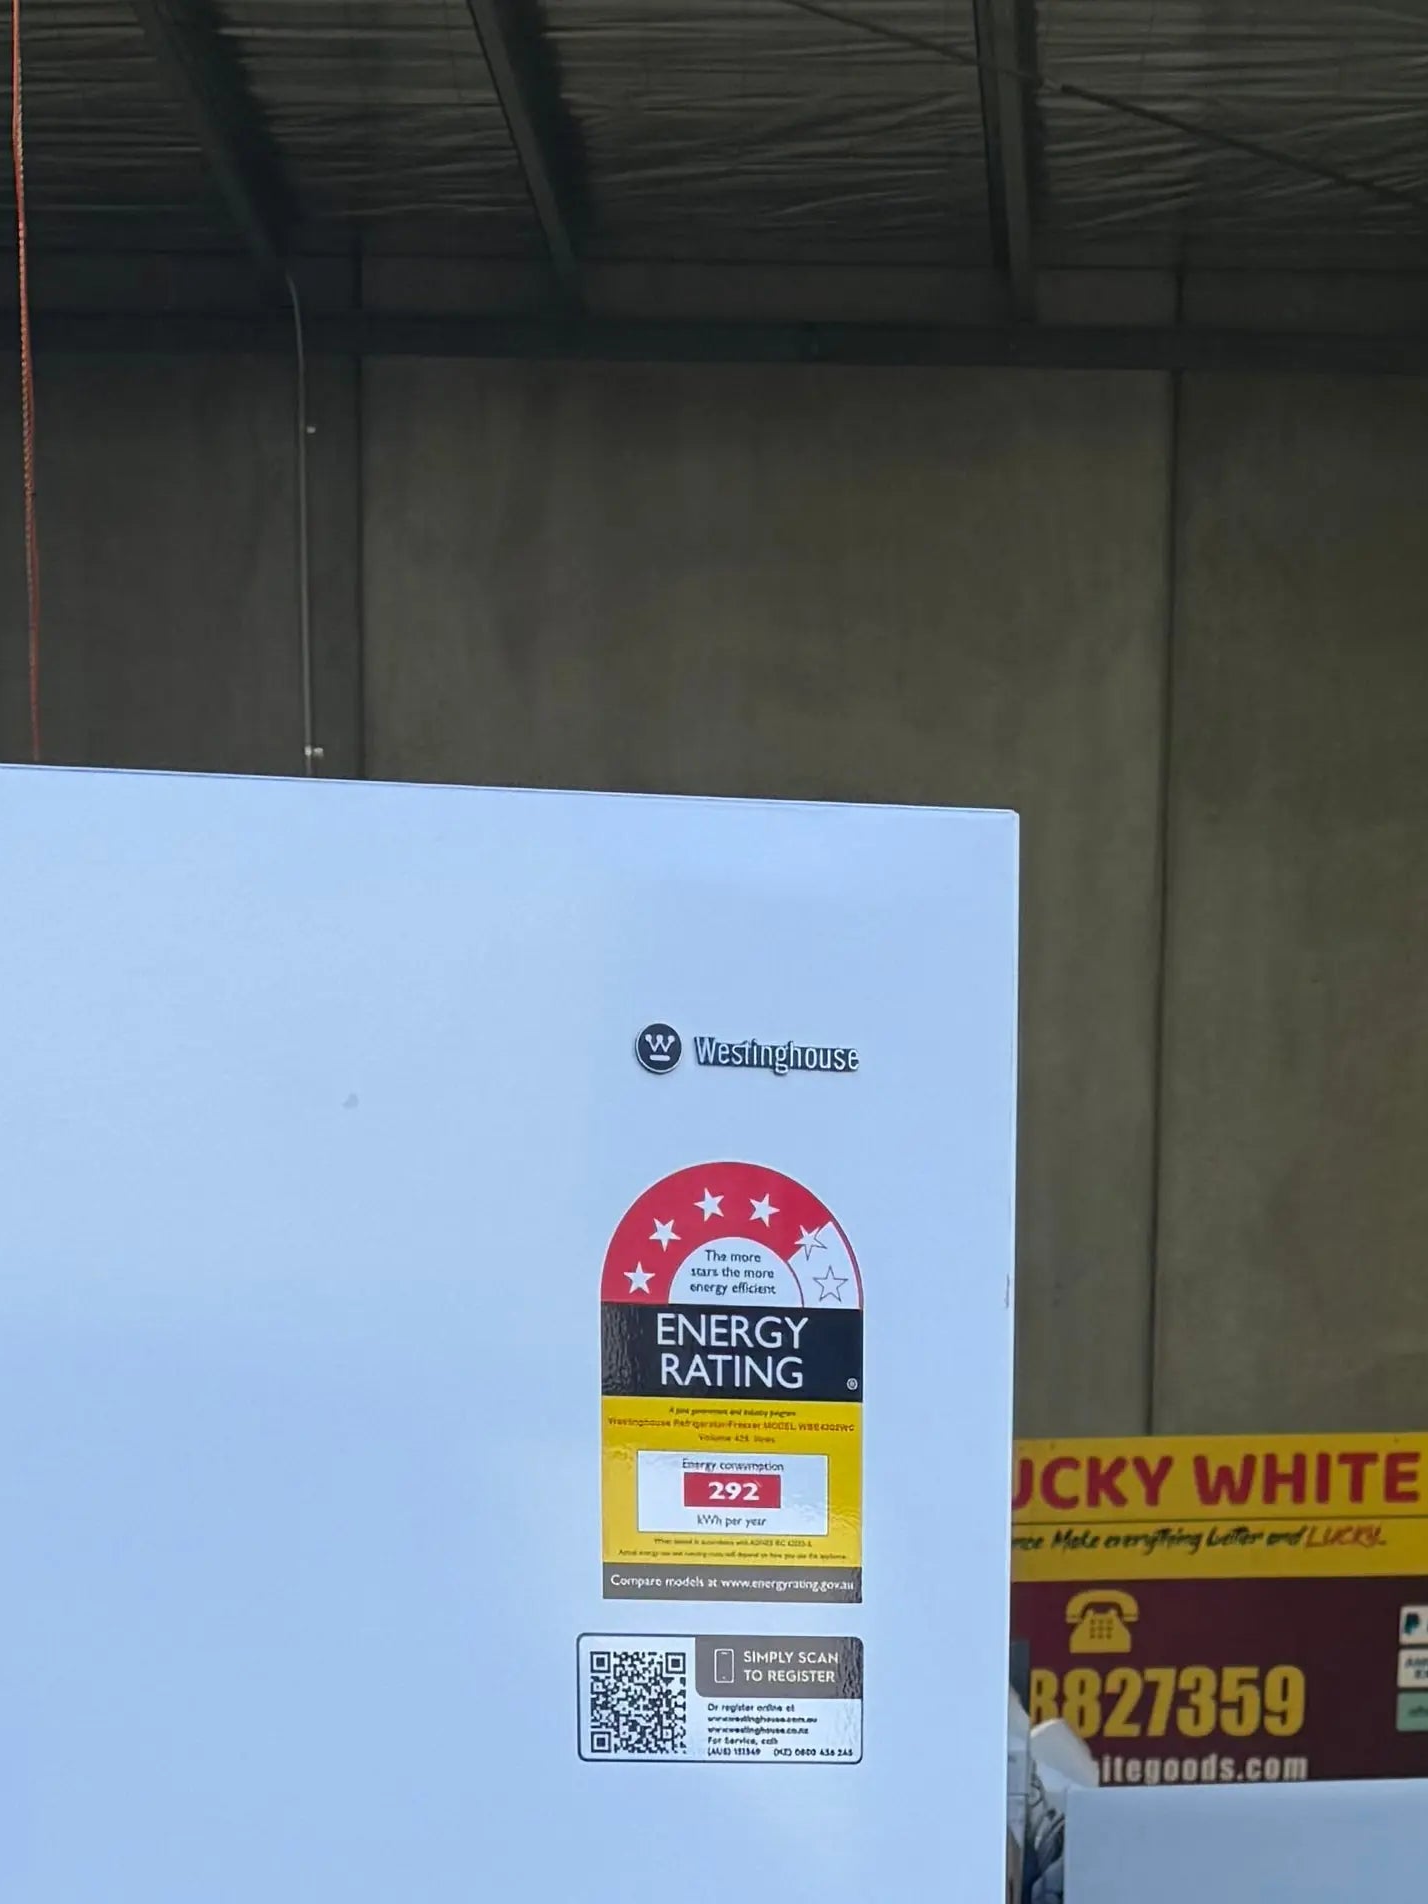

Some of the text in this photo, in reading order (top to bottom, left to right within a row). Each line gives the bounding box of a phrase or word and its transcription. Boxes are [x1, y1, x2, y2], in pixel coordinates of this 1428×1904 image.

[694, 1036, 860, 1074] Westinghouse
[705, 1250, 761, 1262] The more
[722, 1268, 740, 1277] the
[744, 1270, 774, 1278] more
[690, 1282, 776, 1295] energy efficient
[656, 1312, 808, 1349] ENERGY
[660, 1353, 804, 1389] RATING
[682, 1458, 784, 1474] Energy consumption
[1193, 1451, 1420, 1506] WHITE
[708, 1482, 760, 1500] 292
[697, 1514, 766, 1528] kWh per year
[1104, 1529, 1203, 1556] everything
[610, 1574, 854, 1592] Compare models at www.energyrating.gov.au
[744, 1650, 838, 1664] SIMPLY SCAN
[744, 1670, 835, 1683] TO REGISTER
[1098, 1753, 1308, 1785] itegoods.com
